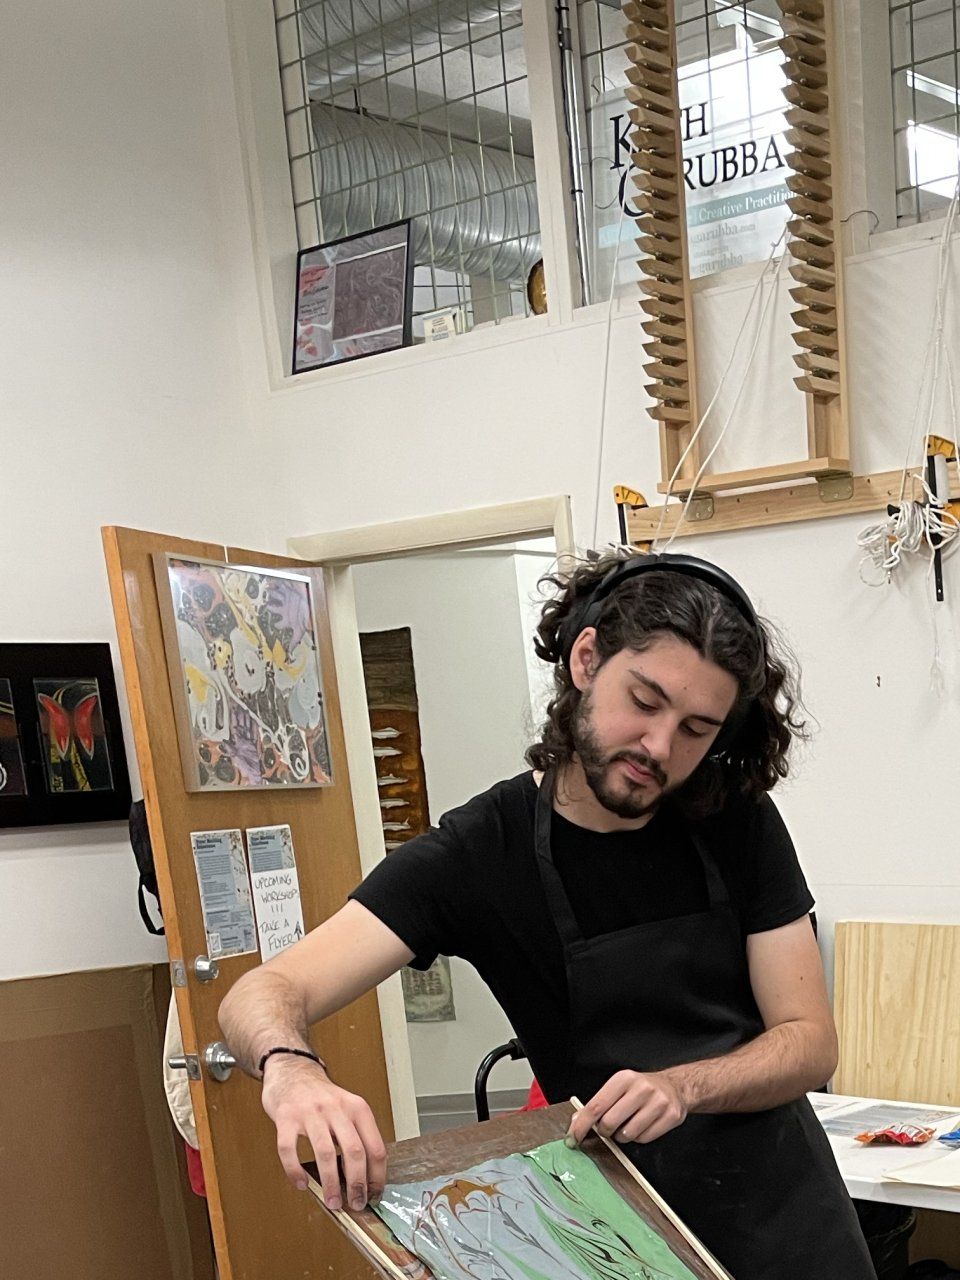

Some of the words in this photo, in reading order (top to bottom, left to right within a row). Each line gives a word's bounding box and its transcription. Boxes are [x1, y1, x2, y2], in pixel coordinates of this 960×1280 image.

[255, 874, 292, 889] UPCOMING
[260, 921, 280, 933] TAKE
[283, 918, 290, 928] A
[268, 933, 295, 951] FLYER
